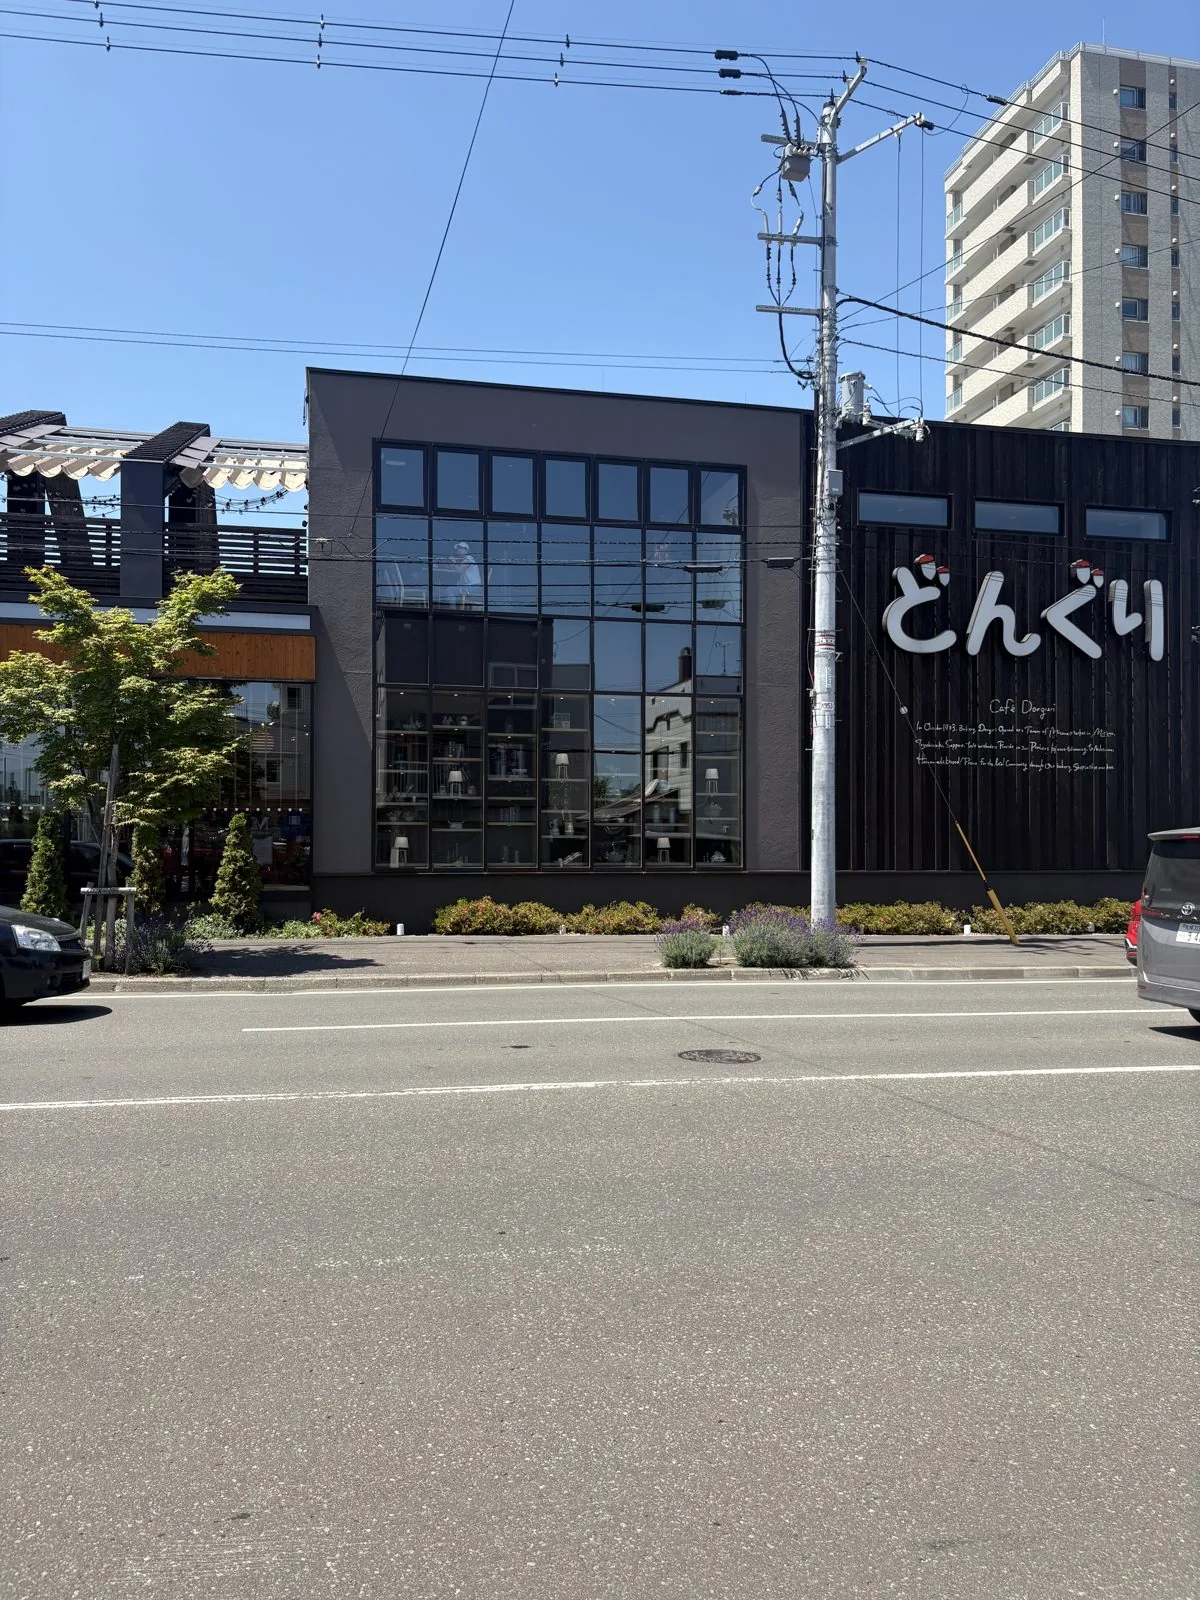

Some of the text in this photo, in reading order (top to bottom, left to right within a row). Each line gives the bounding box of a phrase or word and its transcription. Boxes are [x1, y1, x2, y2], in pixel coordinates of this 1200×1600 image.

[882, 553, 1164, 661] どんぐり
[989, 698, 1016, 715] Café
